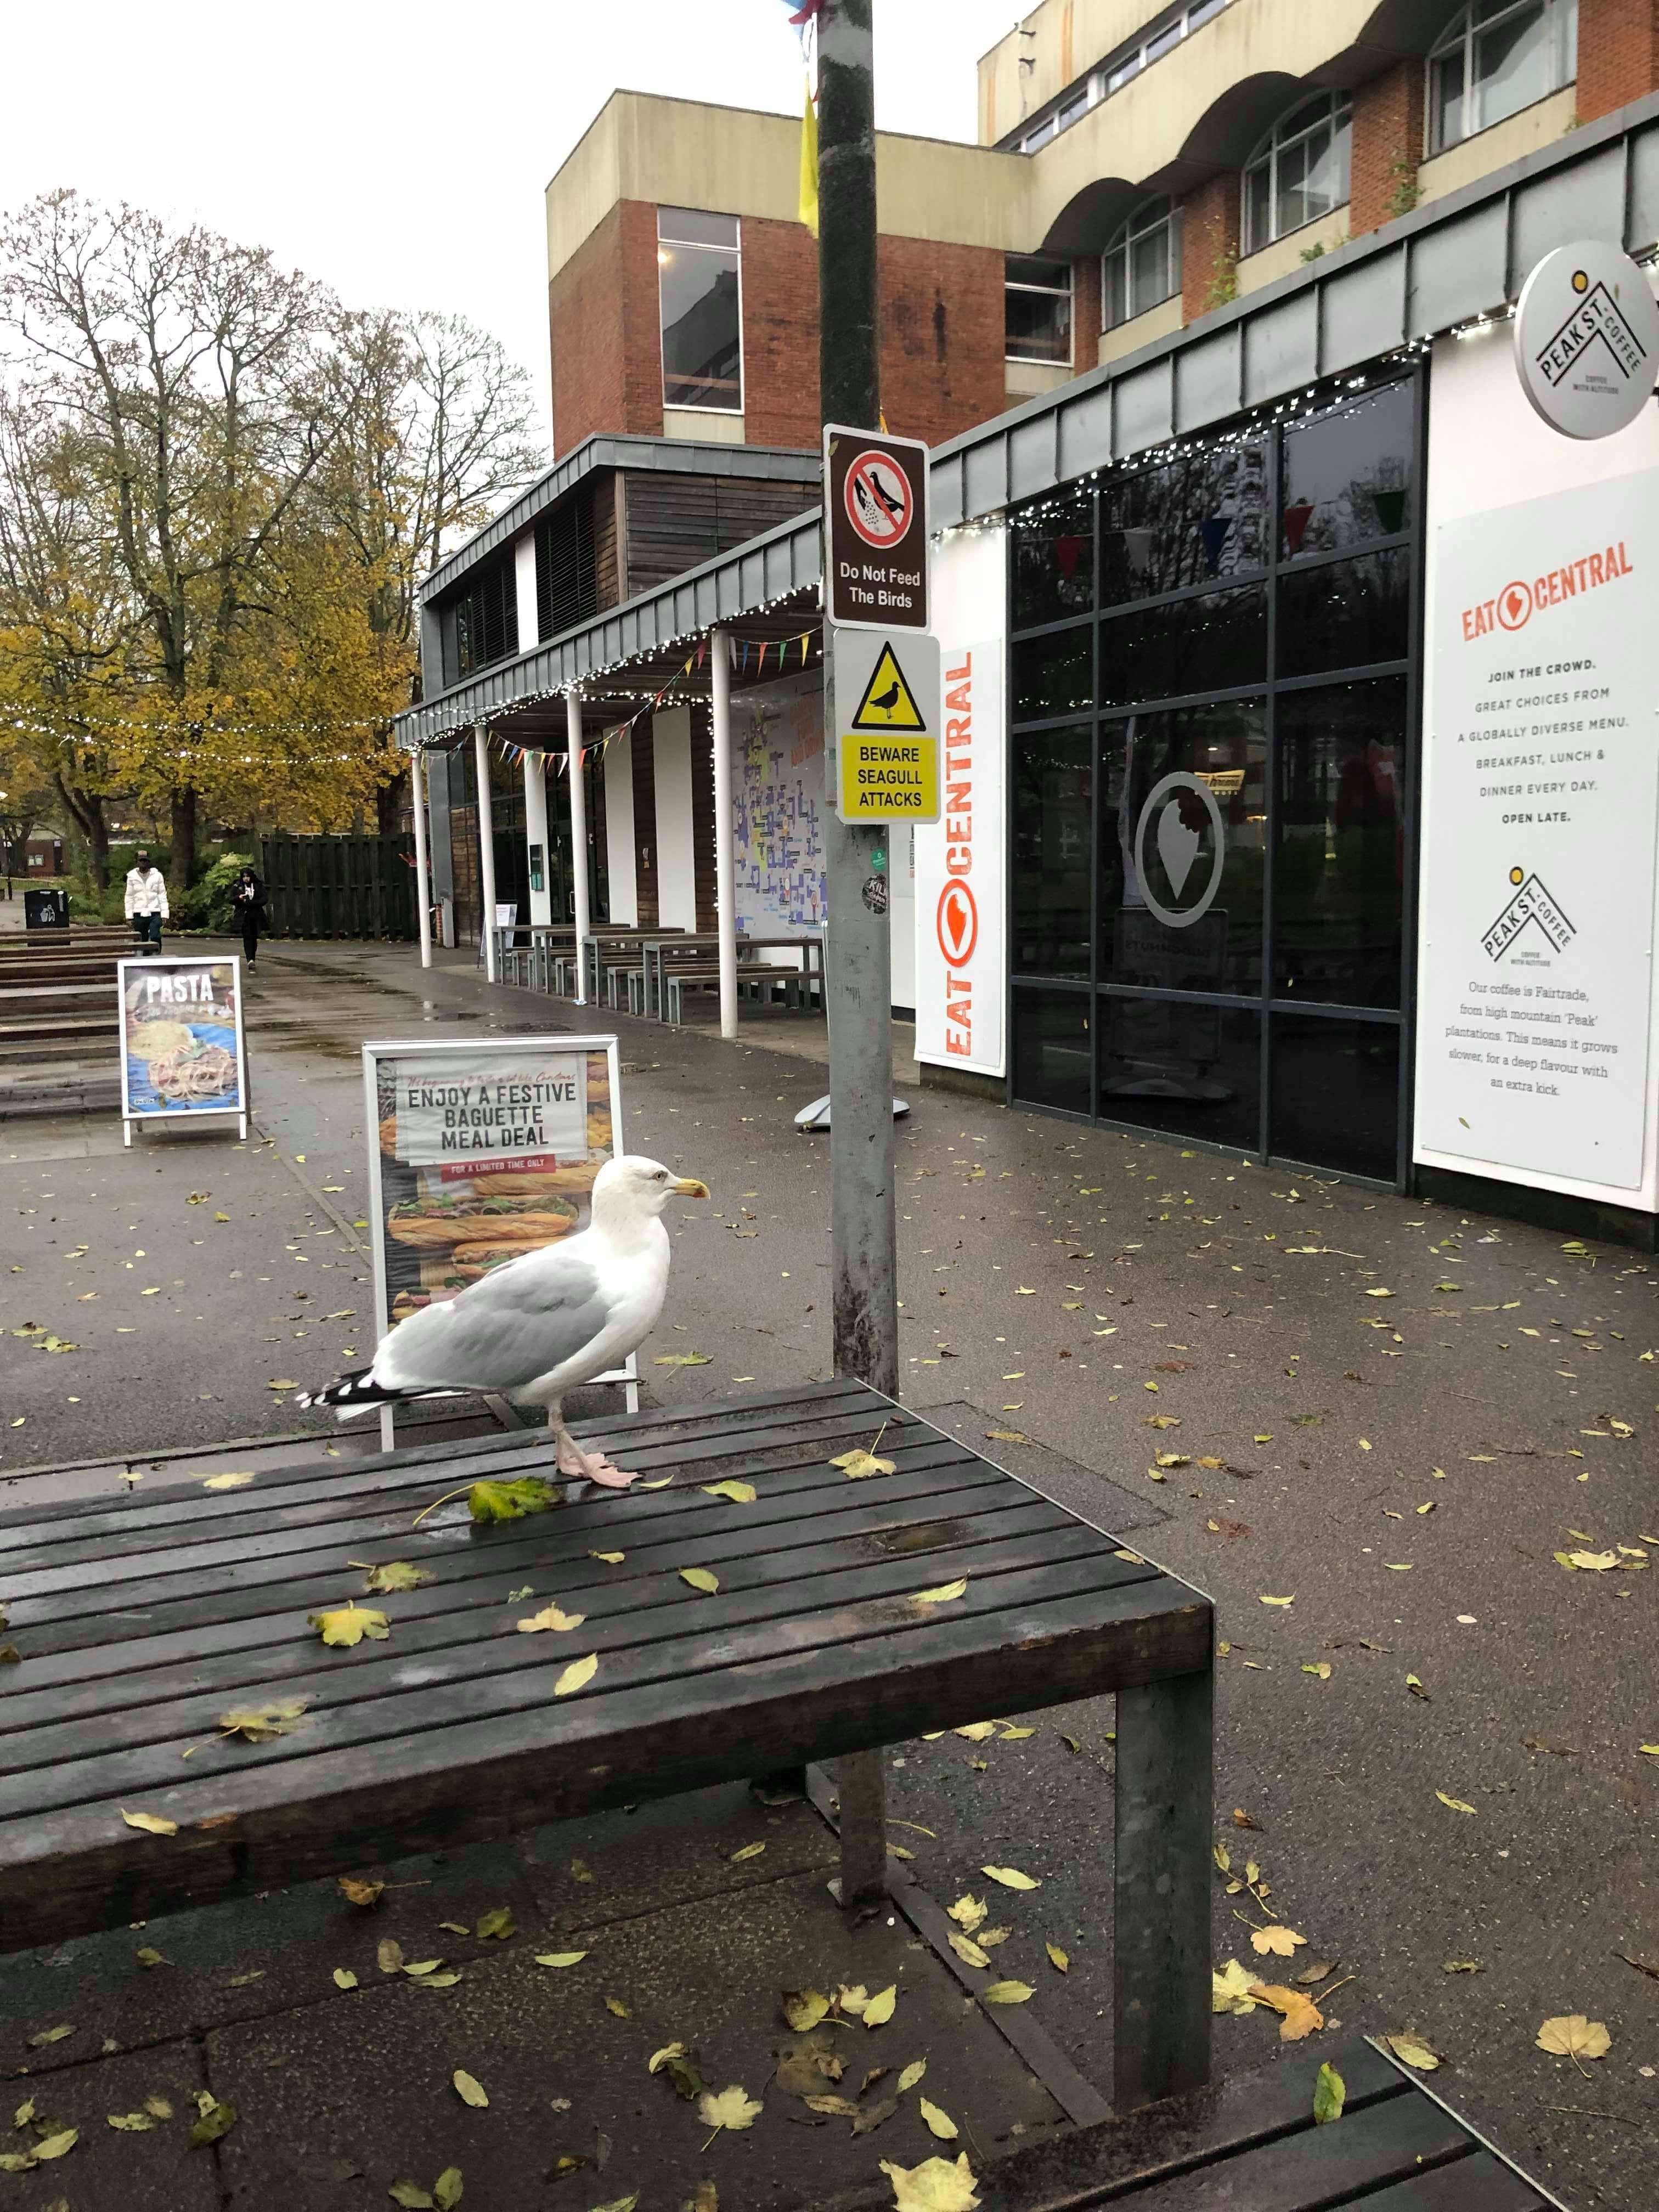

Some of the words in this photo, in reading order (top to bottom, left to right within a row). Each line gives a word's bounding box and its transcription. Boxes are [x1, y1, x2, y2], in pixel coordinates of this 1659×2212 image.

[1540, 324, 1585, 380] PEAK
[1605, 317, 1641, 371] COFFEE
[840, 562, 859, 579] Do
[863, 565, 886, 582] Not
[889, 568, 921, 586] Feed
[849, 587, 874, 604] The
[878, 590, 912, 608] Birds
[1462, 599, 1495, 642] EAT
[1534, 541, 1633, 611] CENTRAL
[1488, 670, 1515, 683] JOIN
[1519, 666, 1542, 679] THE
[1546, 659, 1596, 675] CROWD.
[1475, 699, 1512, 713] GREAT
[1516, 692, 1568, 709] CHOICES
[1573, 687, 1610, 702] FROM
[1458, 733, 1465, 742] A
[1469, 727, 1527, 742] GLOBALLY
[1531, 720, 1584, 736] DIVERSE
[1588, 716, 1629, 730] MENU.
[860, 746, 919, 762] BEWARE
[946, 652, 972, 876] CENTRAL
[1476, 754, 1545, 769] BREAKFAST,
[1550, 751, 1592, 764] LUNCH
[1596, 749, 1604, 760] &
[858, 769, 923, 785] SEAGULL
[1480, 785, 1522, 797] DINNER
[1527, 782, 1566, 794] EVERY
[1571, 781, 1598, 792] DAY.
[859, 792, 922, 806] ATTACKS
[1502, 813, 1533, 823] OPEN
[1538, 812, 1571, 822] LATE.
[1484, 910, 1520, 957] PEAK
[1537, 901, 1571, 946] COFFEE
[147, 974, 214, 1003] PASTA
[1469, 981, 1488, 993] Our
[1490, 984, 1521, 996] coffee
[1523, 986, 1532, 996] is
[1535, 986, 1589, 1002] Fairtrade,
[946, 970, 971, 1056] EAT
[1460, 1003, 1482, 1015] from
[1485, 1006, 1508, 1020] high
[1510, 1009, 1561, 1023] mountain
[1445, 1025, 1503, 1041] plantations.
[1506, 1031, 1528, 1044] This
[1531, 1036, 1567, 1048] means
[1570, 1038, 1578, 1049] it
[1582, 1042, 1617, 1054] grows
[1449, 1048, 1483, 1062] slower,
[1486, 1053, 1500, 1064] for
[1503, 1057, 1509, 1065] a
[1511, 1056, 1537, 1070] deep
[1541, 1059, 1578, 1074] flavour
[1582, 1066, 1608, 1078] with
[409, 1087, 470, 1108] ENJOY
[479, 1086, 490, 1105] A
[496, 1082, 576, 1104] FESTIVE
[1491, 1078, 1503, 1088] an
[1506, 1081, 1533, 1092] extra
[445, 1105, 543, 1128] BAGUETTE
[442, 1130, 494, 1150] MEAL
[501, 1126, 549, 1147] DEAL
[475, 1162, 504, 1171] LIMITED
[508, 1160, 525, 1169] TIME
[527, 1159, 544, 1167] ONLY
